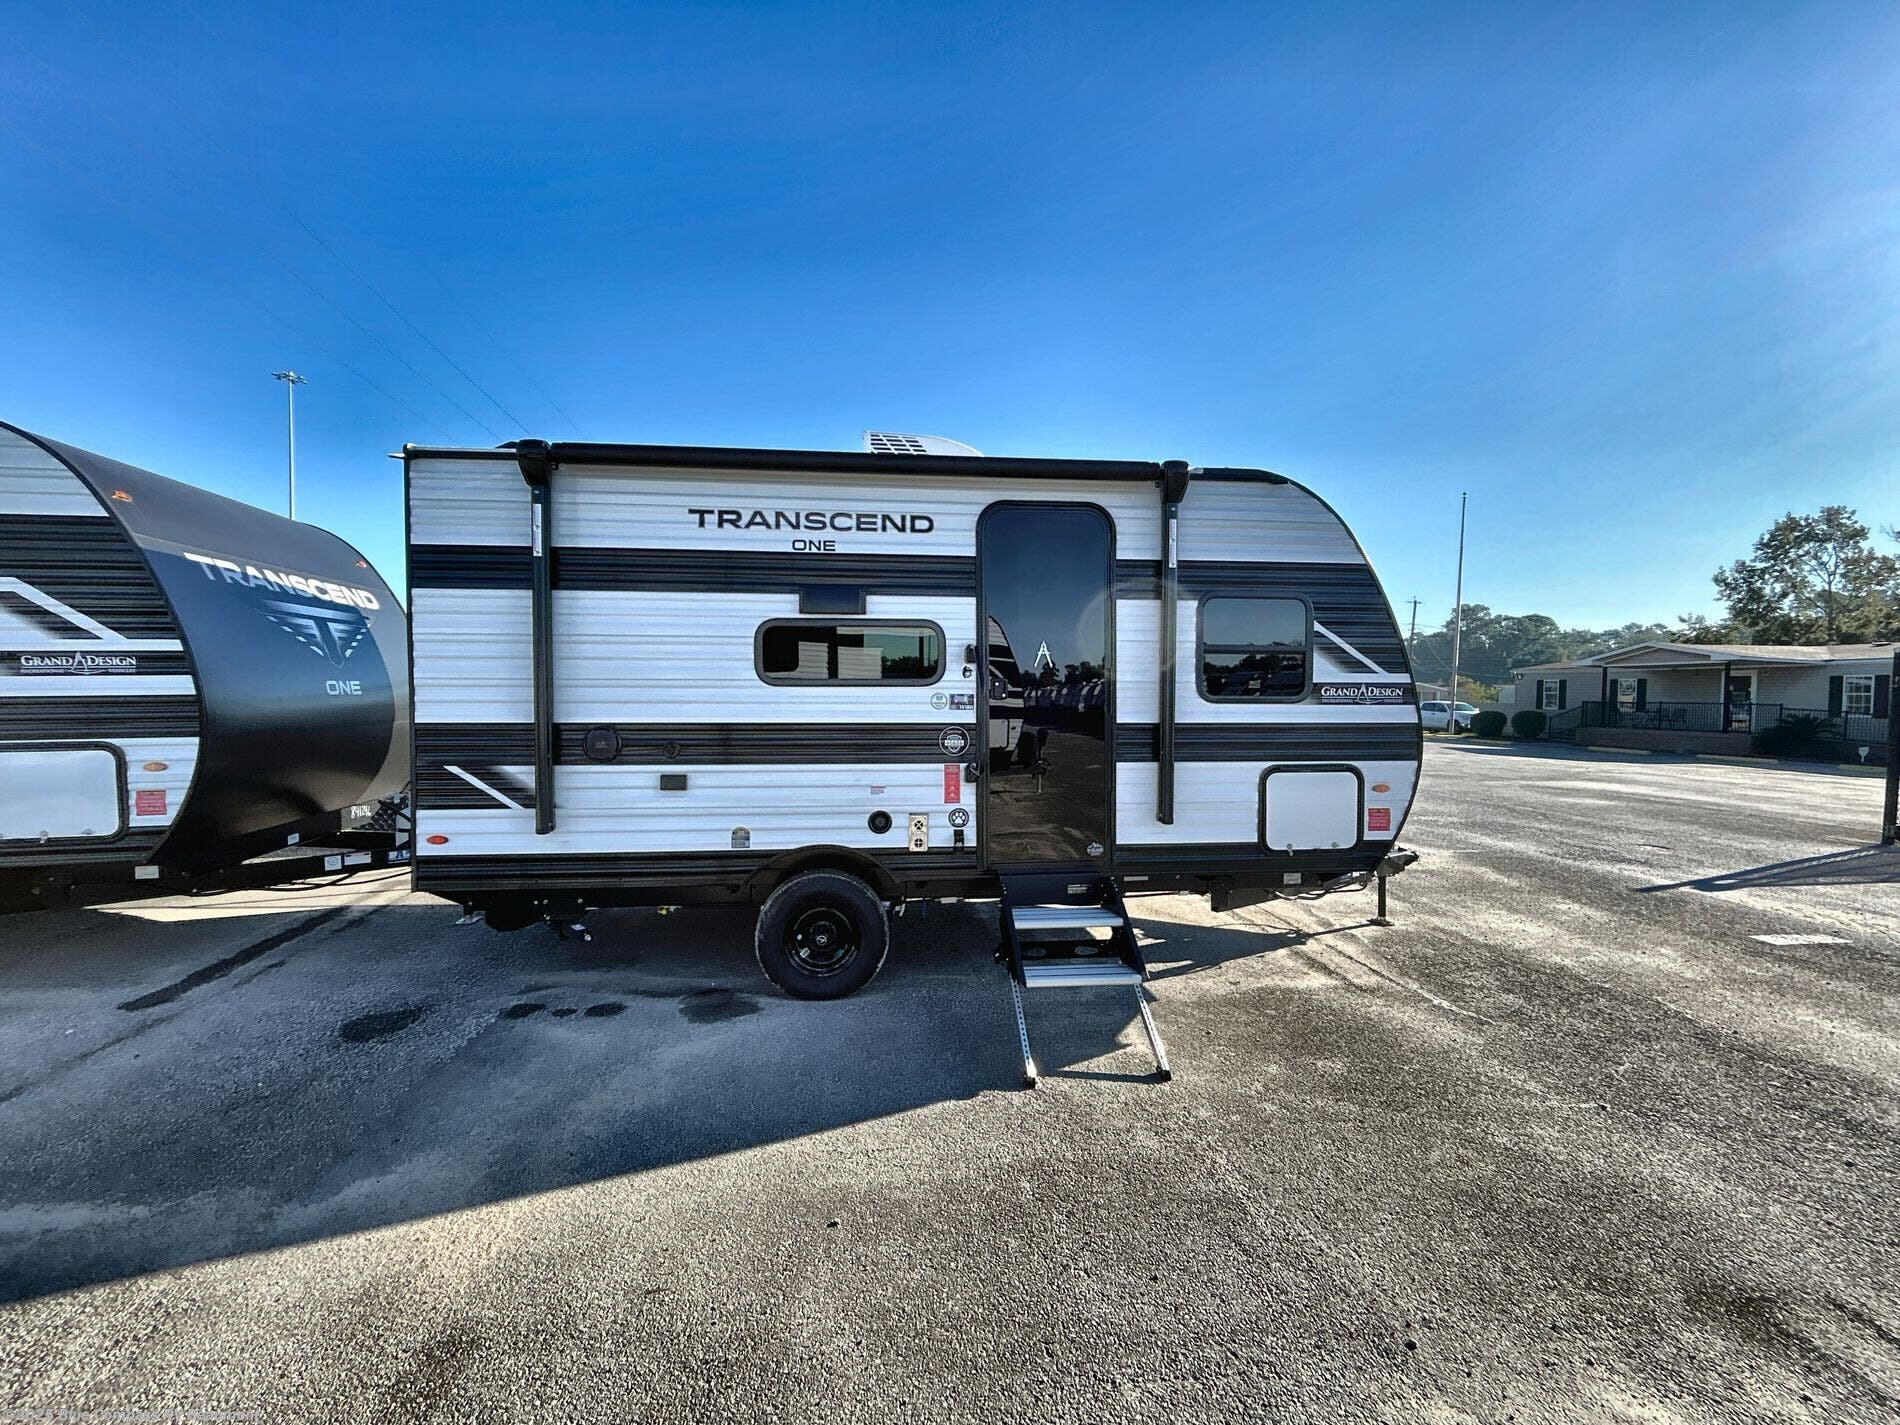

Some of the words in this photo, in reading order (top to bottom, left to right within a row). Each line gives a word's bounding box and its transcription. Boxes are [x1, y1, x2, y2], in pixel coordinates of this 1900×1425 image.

[688, 508, 935, 534] TRANSCEND
[792, 539, 836, 552] ONE
[183, 551, 380, 610] TRANSCEND
[20, 655, 73, 666] GRAND
[86, 655, 137, 666] DESIGN
[325, 680, 362, 696] ONE
[1321, 686, 1358, 697] GRAND
[1367, 686, 1404, 697] DESIGN
